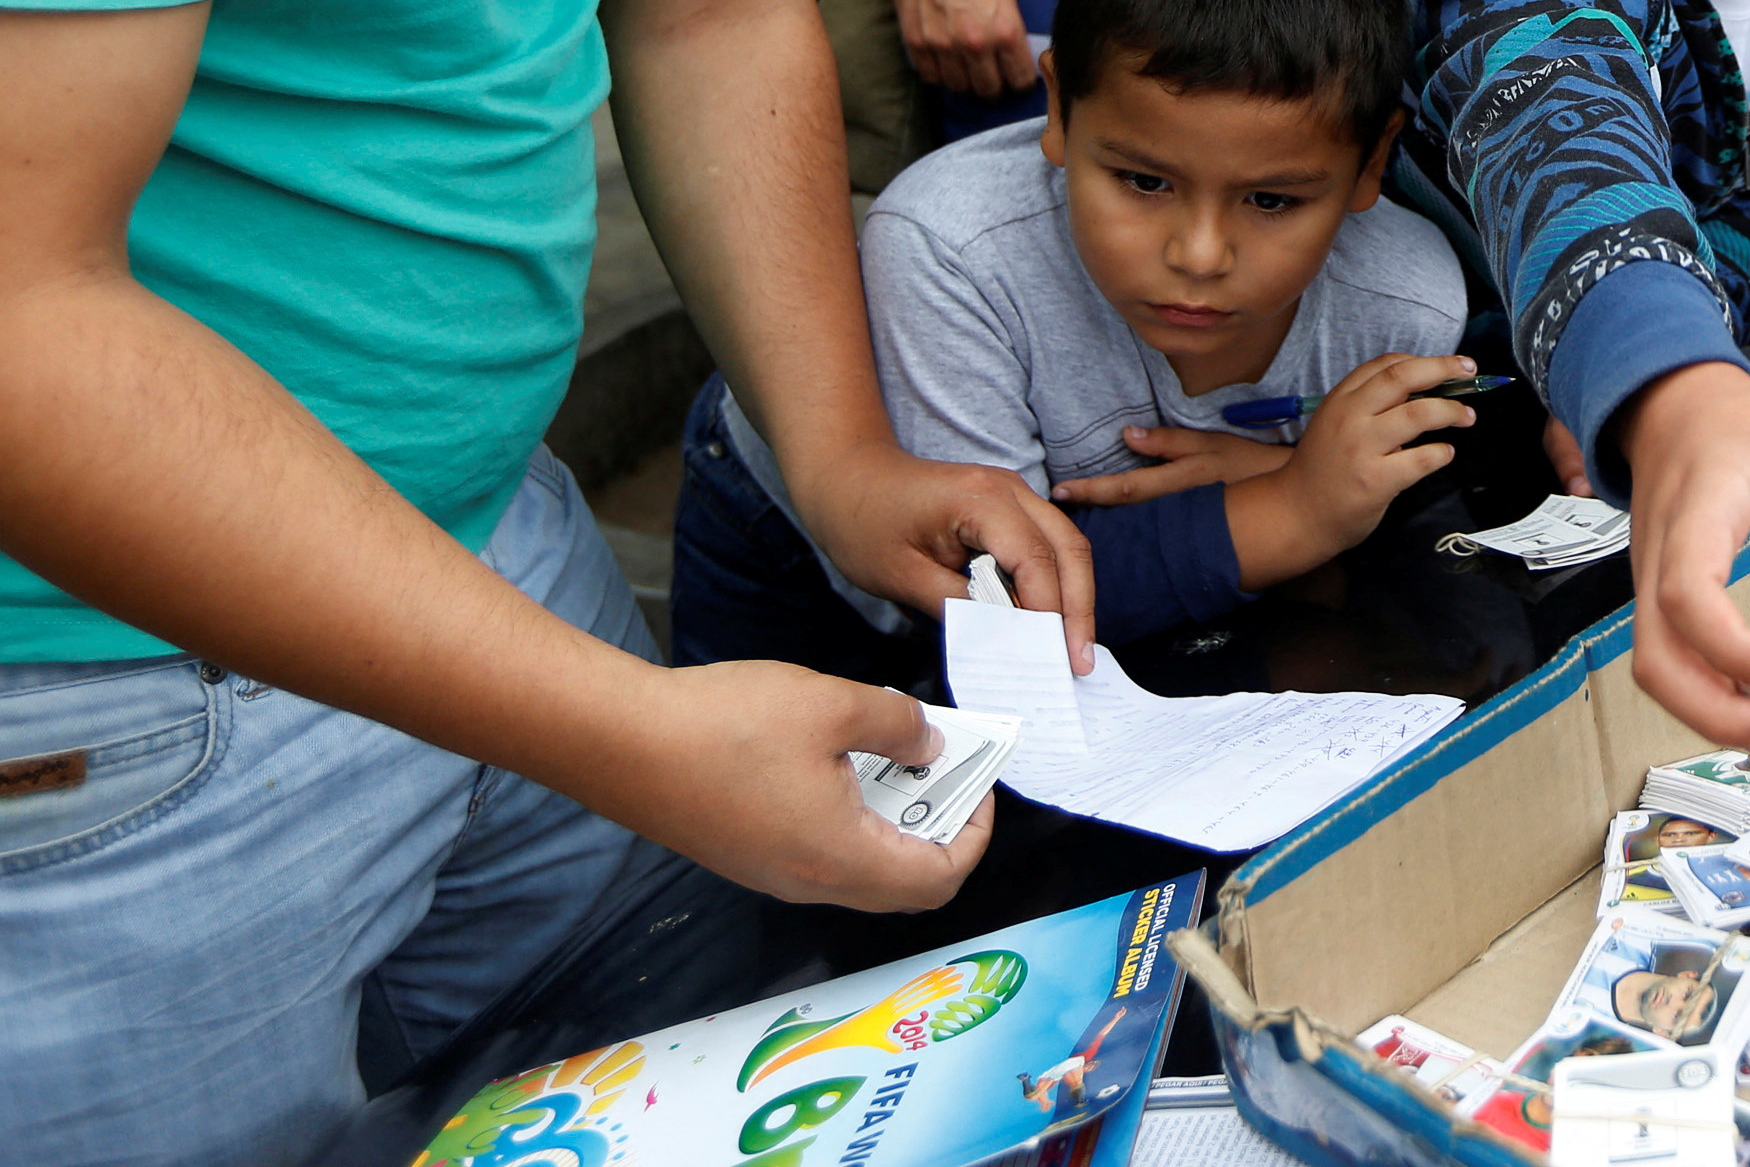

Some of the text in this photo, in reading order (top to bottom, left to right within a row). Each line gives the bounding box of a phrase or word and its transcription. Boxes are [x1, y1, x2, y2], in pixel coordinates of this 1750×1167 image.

[1113, 887, 1161, 999] STICKER ALBUM
[1134, 883, 1177, 992] OFFICIAL LICENSED
[892, 1010, 929, 1052] 2014
[855, 1061, 919, 1134] FIFA
